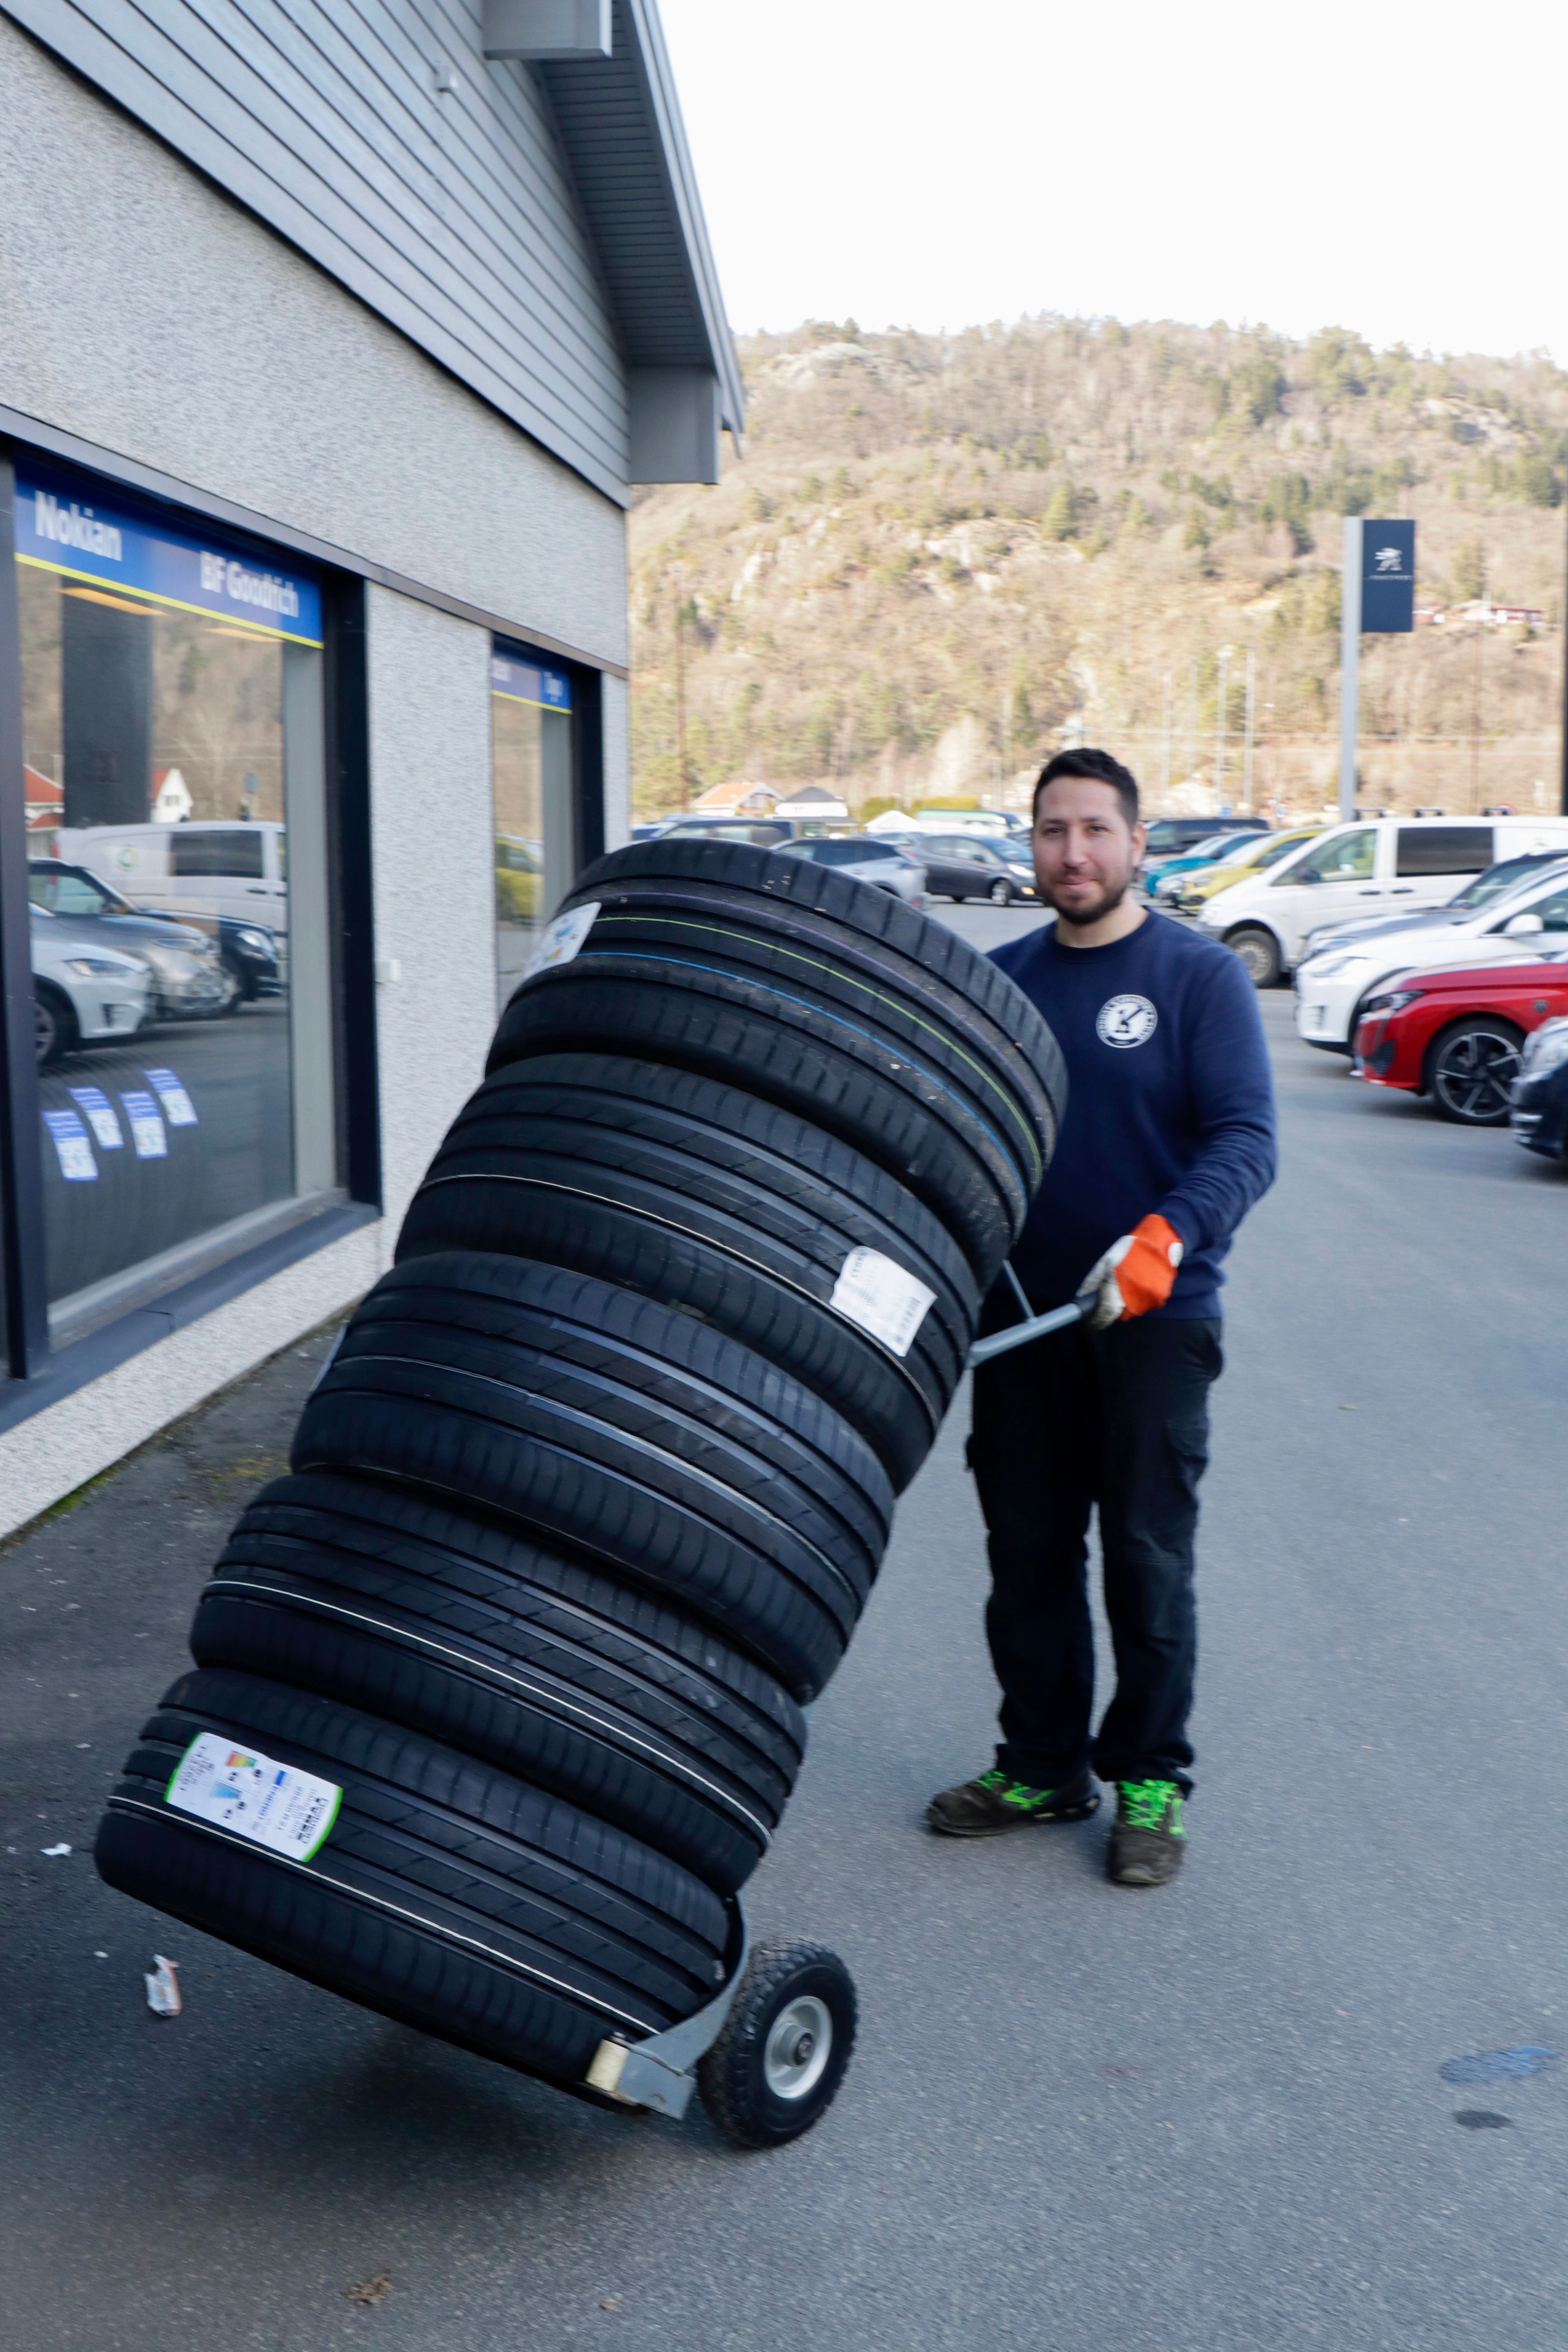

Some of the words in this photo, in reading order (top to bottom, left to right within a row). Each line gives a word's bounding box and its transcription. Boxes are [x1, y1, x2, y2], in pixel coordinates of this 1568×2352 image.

[35, 490, 122, 561] Nokian
[200, 550, 227, 593] BF
[226, 561, 299, 618] Goodrich
